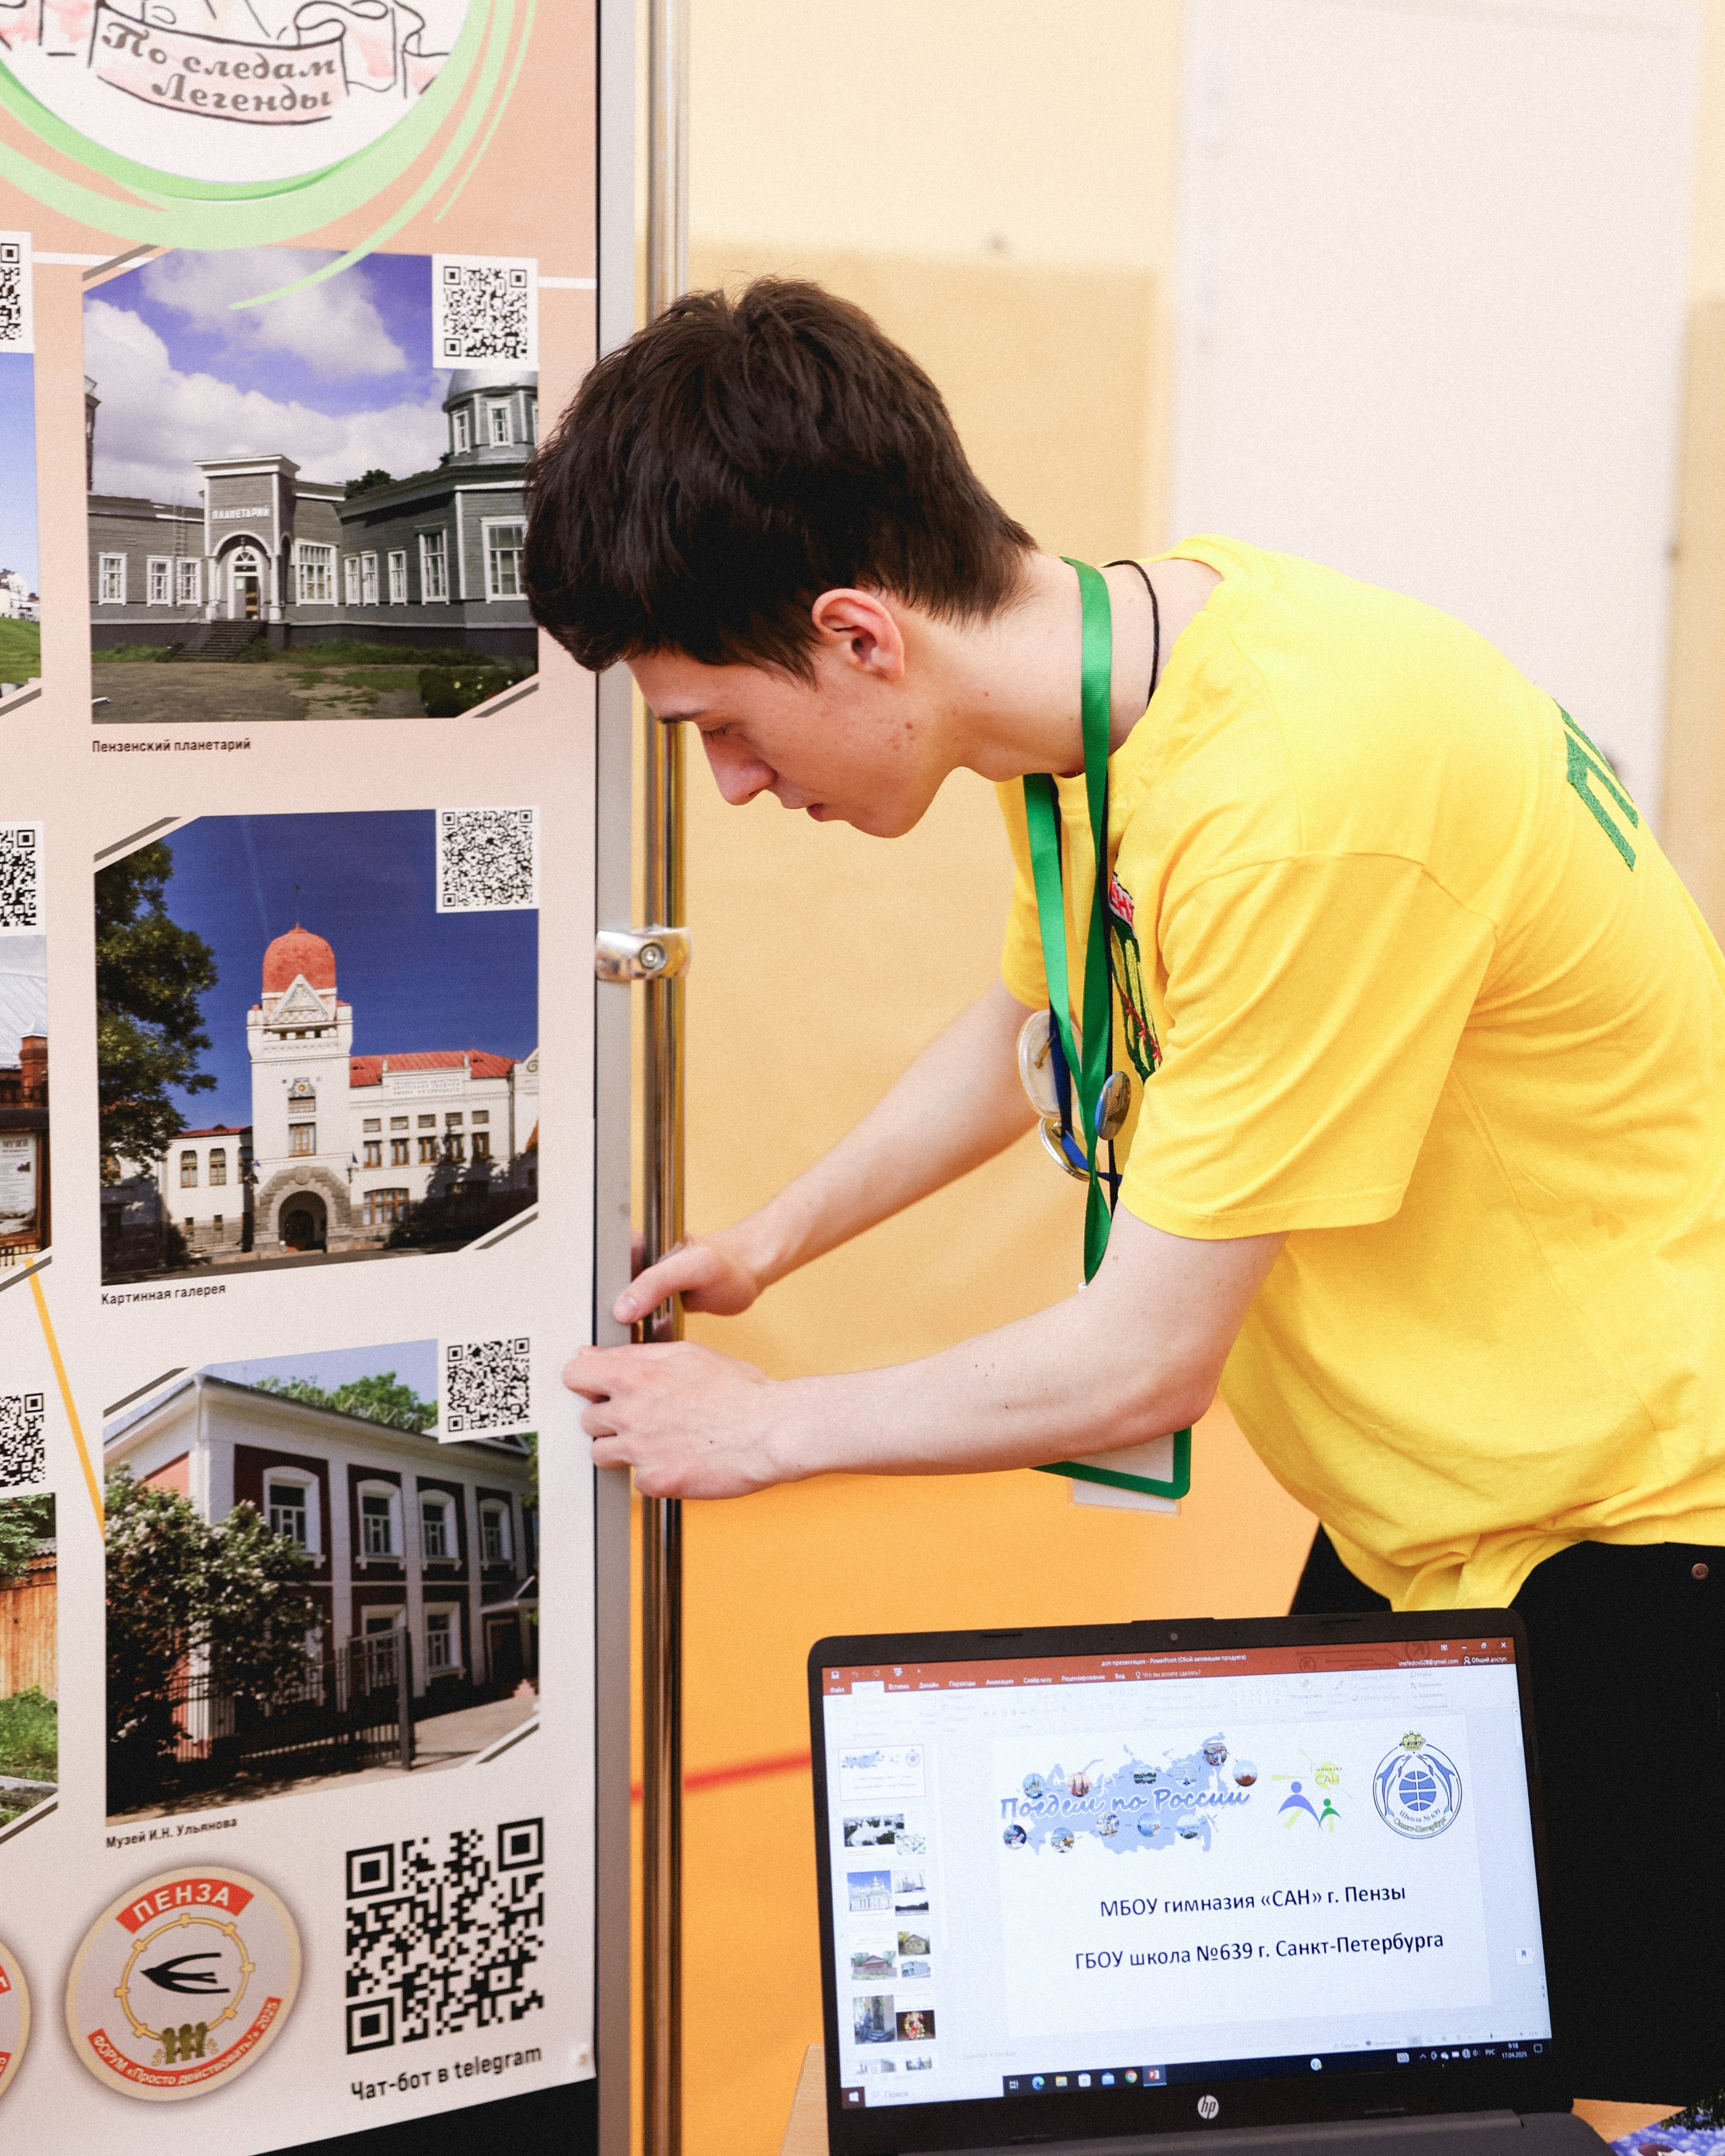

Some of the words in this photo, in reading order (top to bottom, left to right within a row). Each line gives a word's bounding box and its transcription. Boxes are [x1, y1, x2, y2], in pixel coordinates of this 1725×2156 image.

[102, 22, 167, 65] По
[183, 53, 335, 80] следам
[152, 73, 332, 111] Легенды
[92, 738, 170, 753] Пензенский
[174, 738, 251, 752] планетарий
[101, 1290, 171, 1305] Картинная
[175, 1285, 226, 1298] галерея
[1315, 1775, 1339, 1785] САН
[1000, 1794, 1105, 1819] Поедем
[1112, 1798, 1147, 1813] по
[1153, 1787, 1250, 1811] России
[1400, 1810, 1422, 1822] Школа
[1431, 1808, 1441, 1818] 639
[106, 1831, 146, 1848] Музей
[149, 1827, 173, 1841] И.Н.
[177, 1818, 238, 1837] Ульянова
[132, 1883, 229, 1922] ПЕНЗА
[1100, 1897, 1158, 1917] МБОУ
[1164, 1894, 1255, 1914] гимназия
[1261, 1889, 1323, 1907] «САН»
[1327, 1891, 1339, 1904] г.
[1345, 1886, 1406, 1903] Пензы
[1075, 1951, 1123, 1969] ГБОУ
[1129, 1950, 1191, 1966] школа
[1196, 1942, 1253, 1962] №639
[1259, 1945, 1270, 1958] г.
[1276, 1932, 1444, 1957] Санкт-Петербурга
[93, 2035, 129, 2072] ФОРУМ
[126, 2067, 177, 2085] «Просто
[351, 2071, 431, 2100] Чат-бот
[438, 2068, 449, 2083] в
[454, 2047, 542, 2079] telegram
[1201, 2095, 1216, 2120] hp
